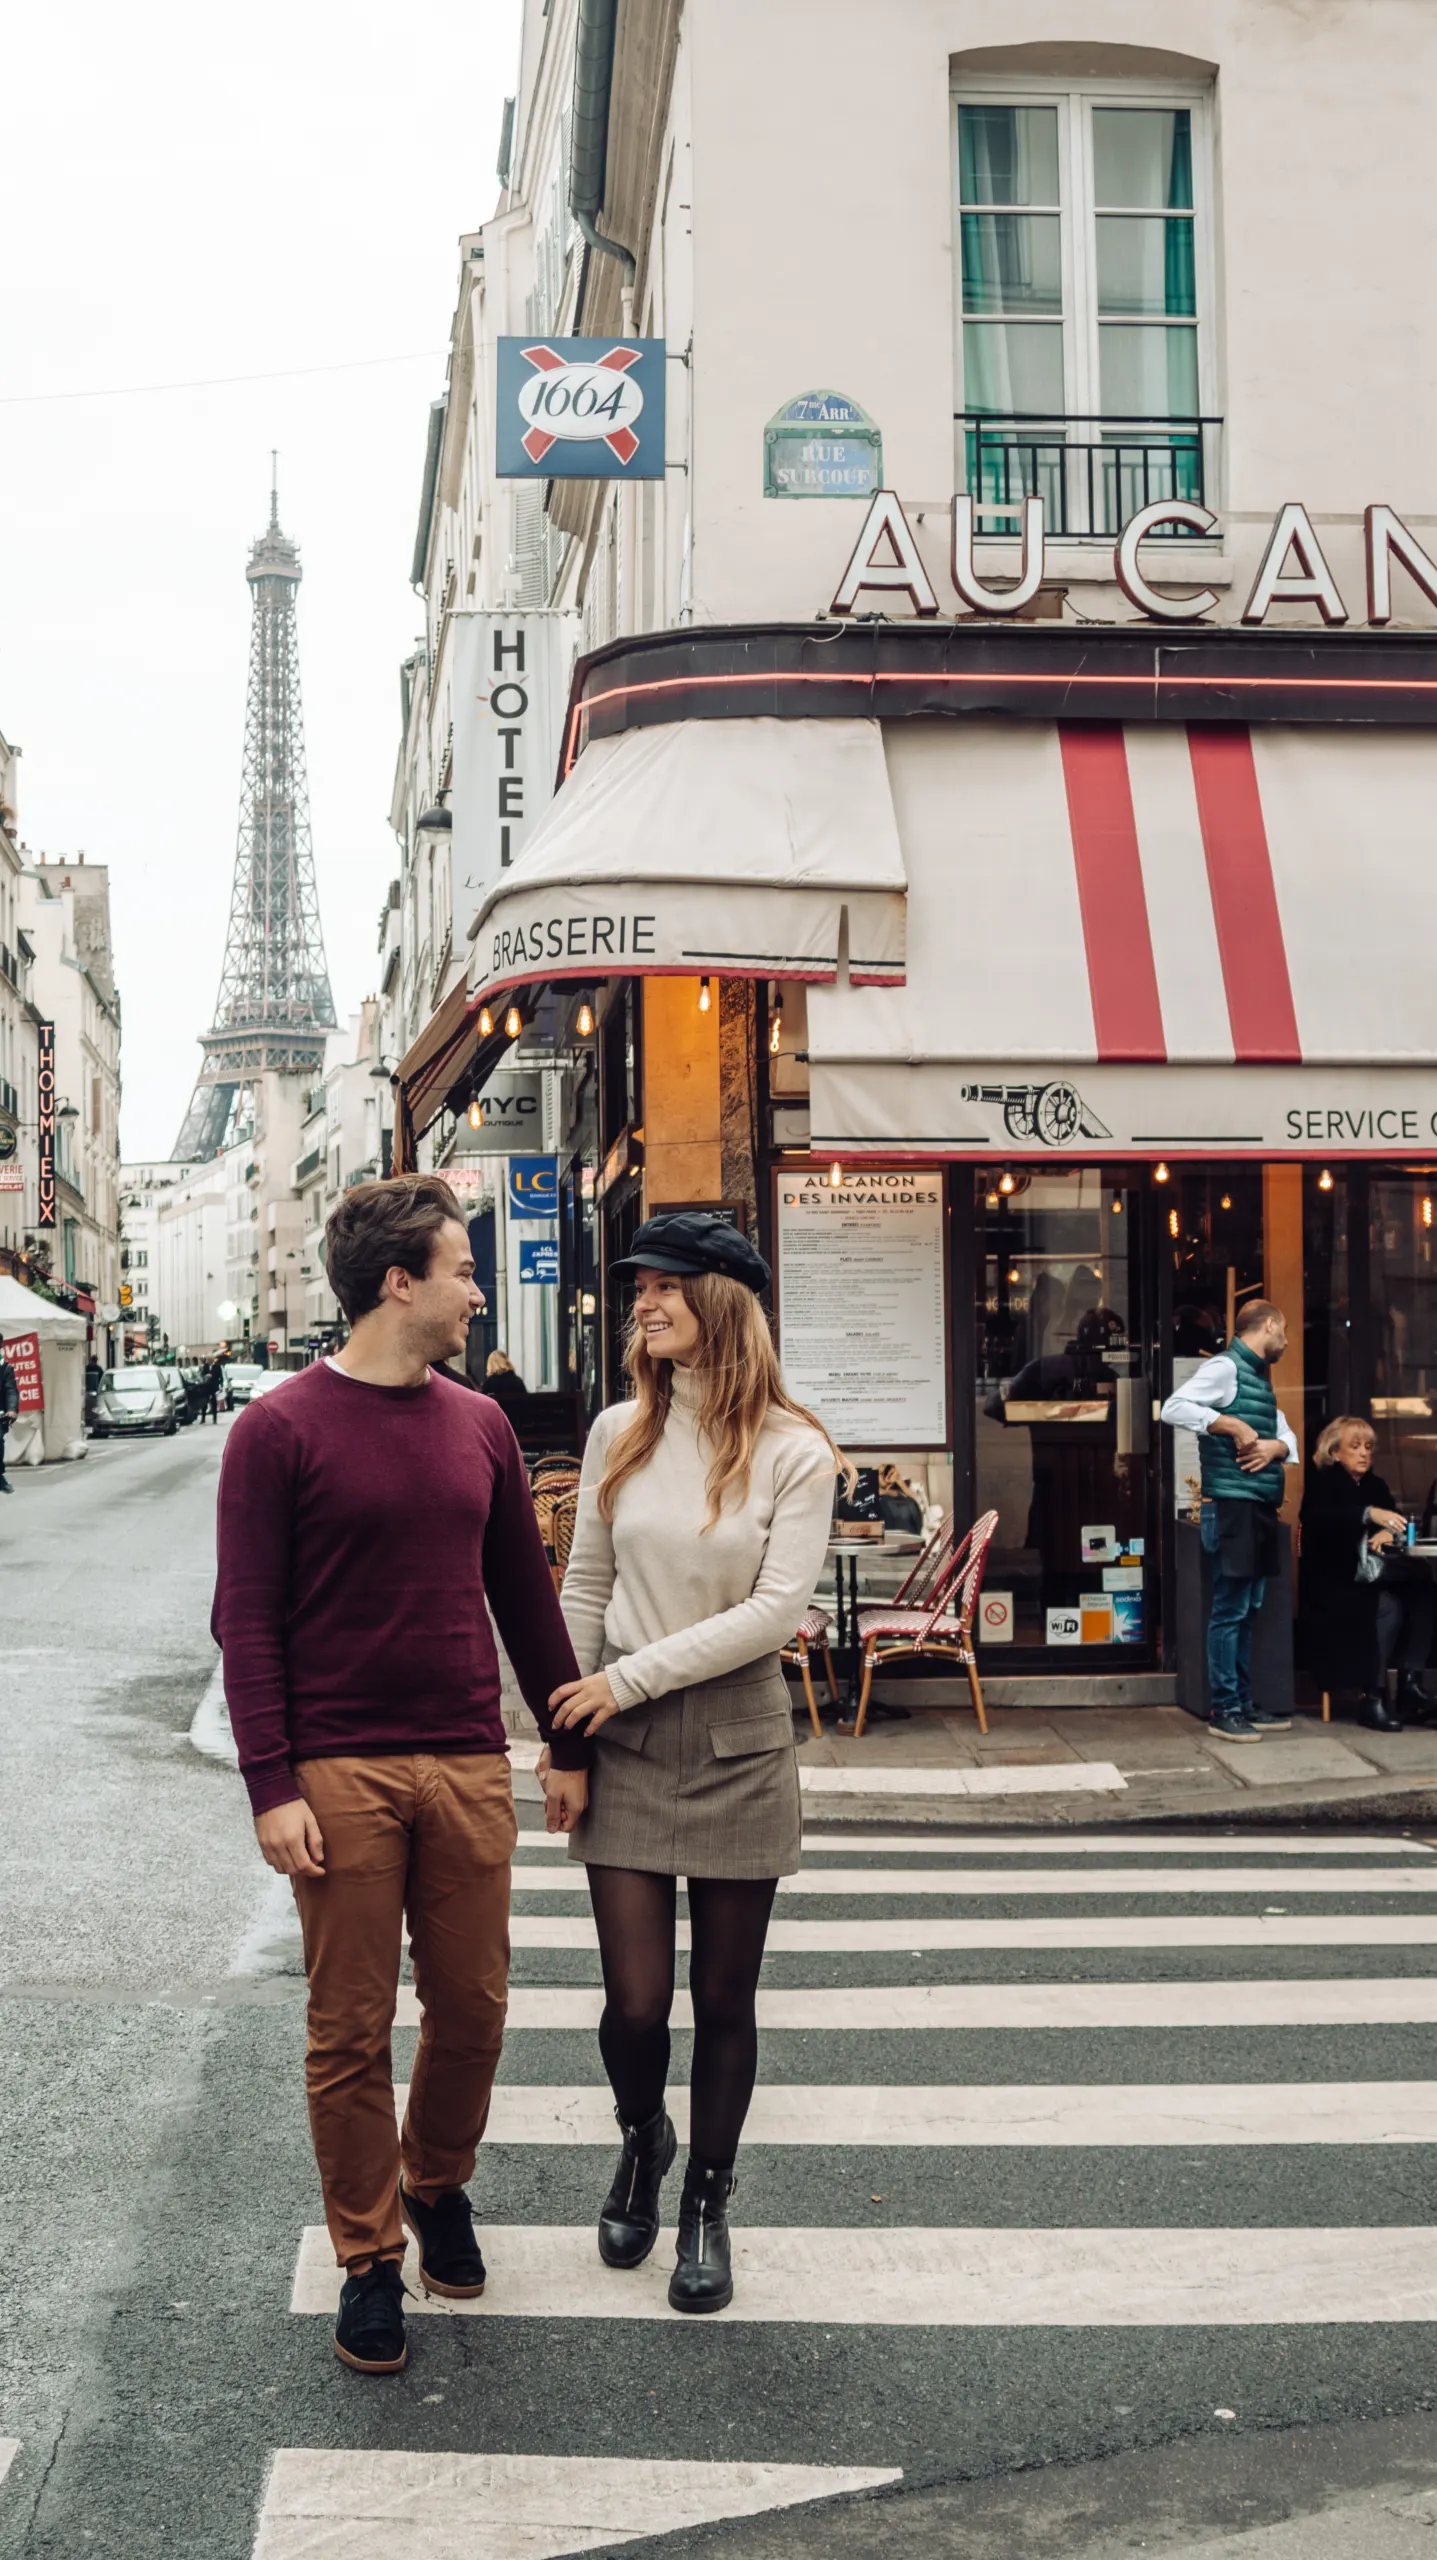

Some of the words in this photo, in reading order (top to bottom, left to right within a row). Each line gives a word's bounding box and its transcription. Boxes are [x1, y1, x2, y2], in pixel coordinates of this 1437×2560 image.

[531, 375, 630, 421] 1664
[802, 446, 846, 462] RUE
[776, 468, 870, 485] SURCOUF
[830, 489, 1045, 615] AU
[490, 630, 529, 867] HOTEL
[492, 916, 656, 972] BRASSERIE
[39, 1026, 54, 1222] THOUMIEUX
[1287, 1110, 1419, 1139] SERVICE
[516, 1171, 573, 1192] LC
[843, 1176, 915, 1188] CANON
[784, 1193, 822, 1205] DES
[831, 1192, 938, 1204] INVALIDES
[0, 1341, 34, 1359] VID
[10, 1360, 36, 1372] UTES
[16, 1374, 38, 1386] ALE
